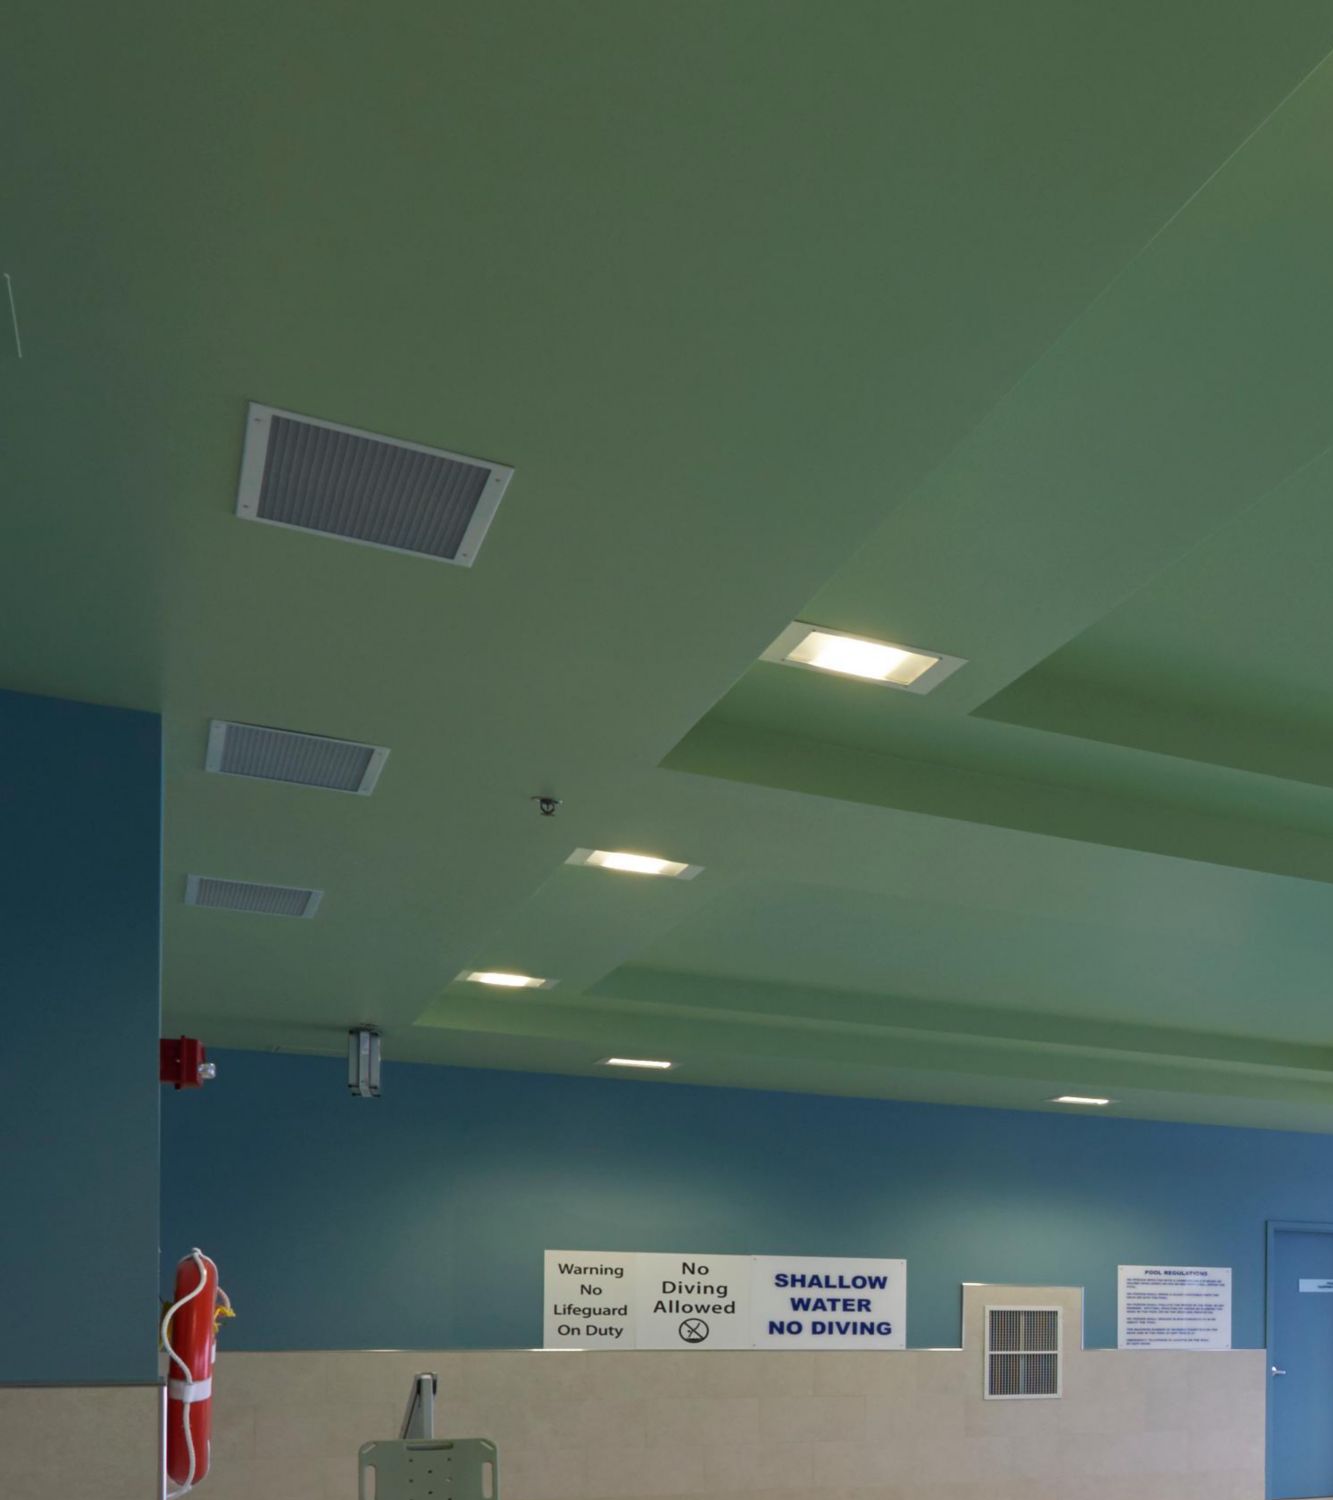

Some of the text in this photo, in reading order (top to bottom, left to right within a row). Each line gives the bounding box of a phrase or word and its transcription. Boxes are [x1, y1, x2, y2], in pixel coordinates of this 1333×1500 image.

[558, 1263, 624, 1278] Warning
[681, 1262, 709, 1276] No
[661, 1280, 729, 1298] Diving
[774, 1273, 888, 1290] SHALLOW
[580, 1284, 603, 1296] No
[553, 1304, 628, 1318] Lifeguard
[653, 1300, 736, 1315] Allowed
[790, 1297, 872, 1313] WATER
[557, 1324, 624, 1339] On Duty
[768, 1320, 893, 1336] NO DIVING
